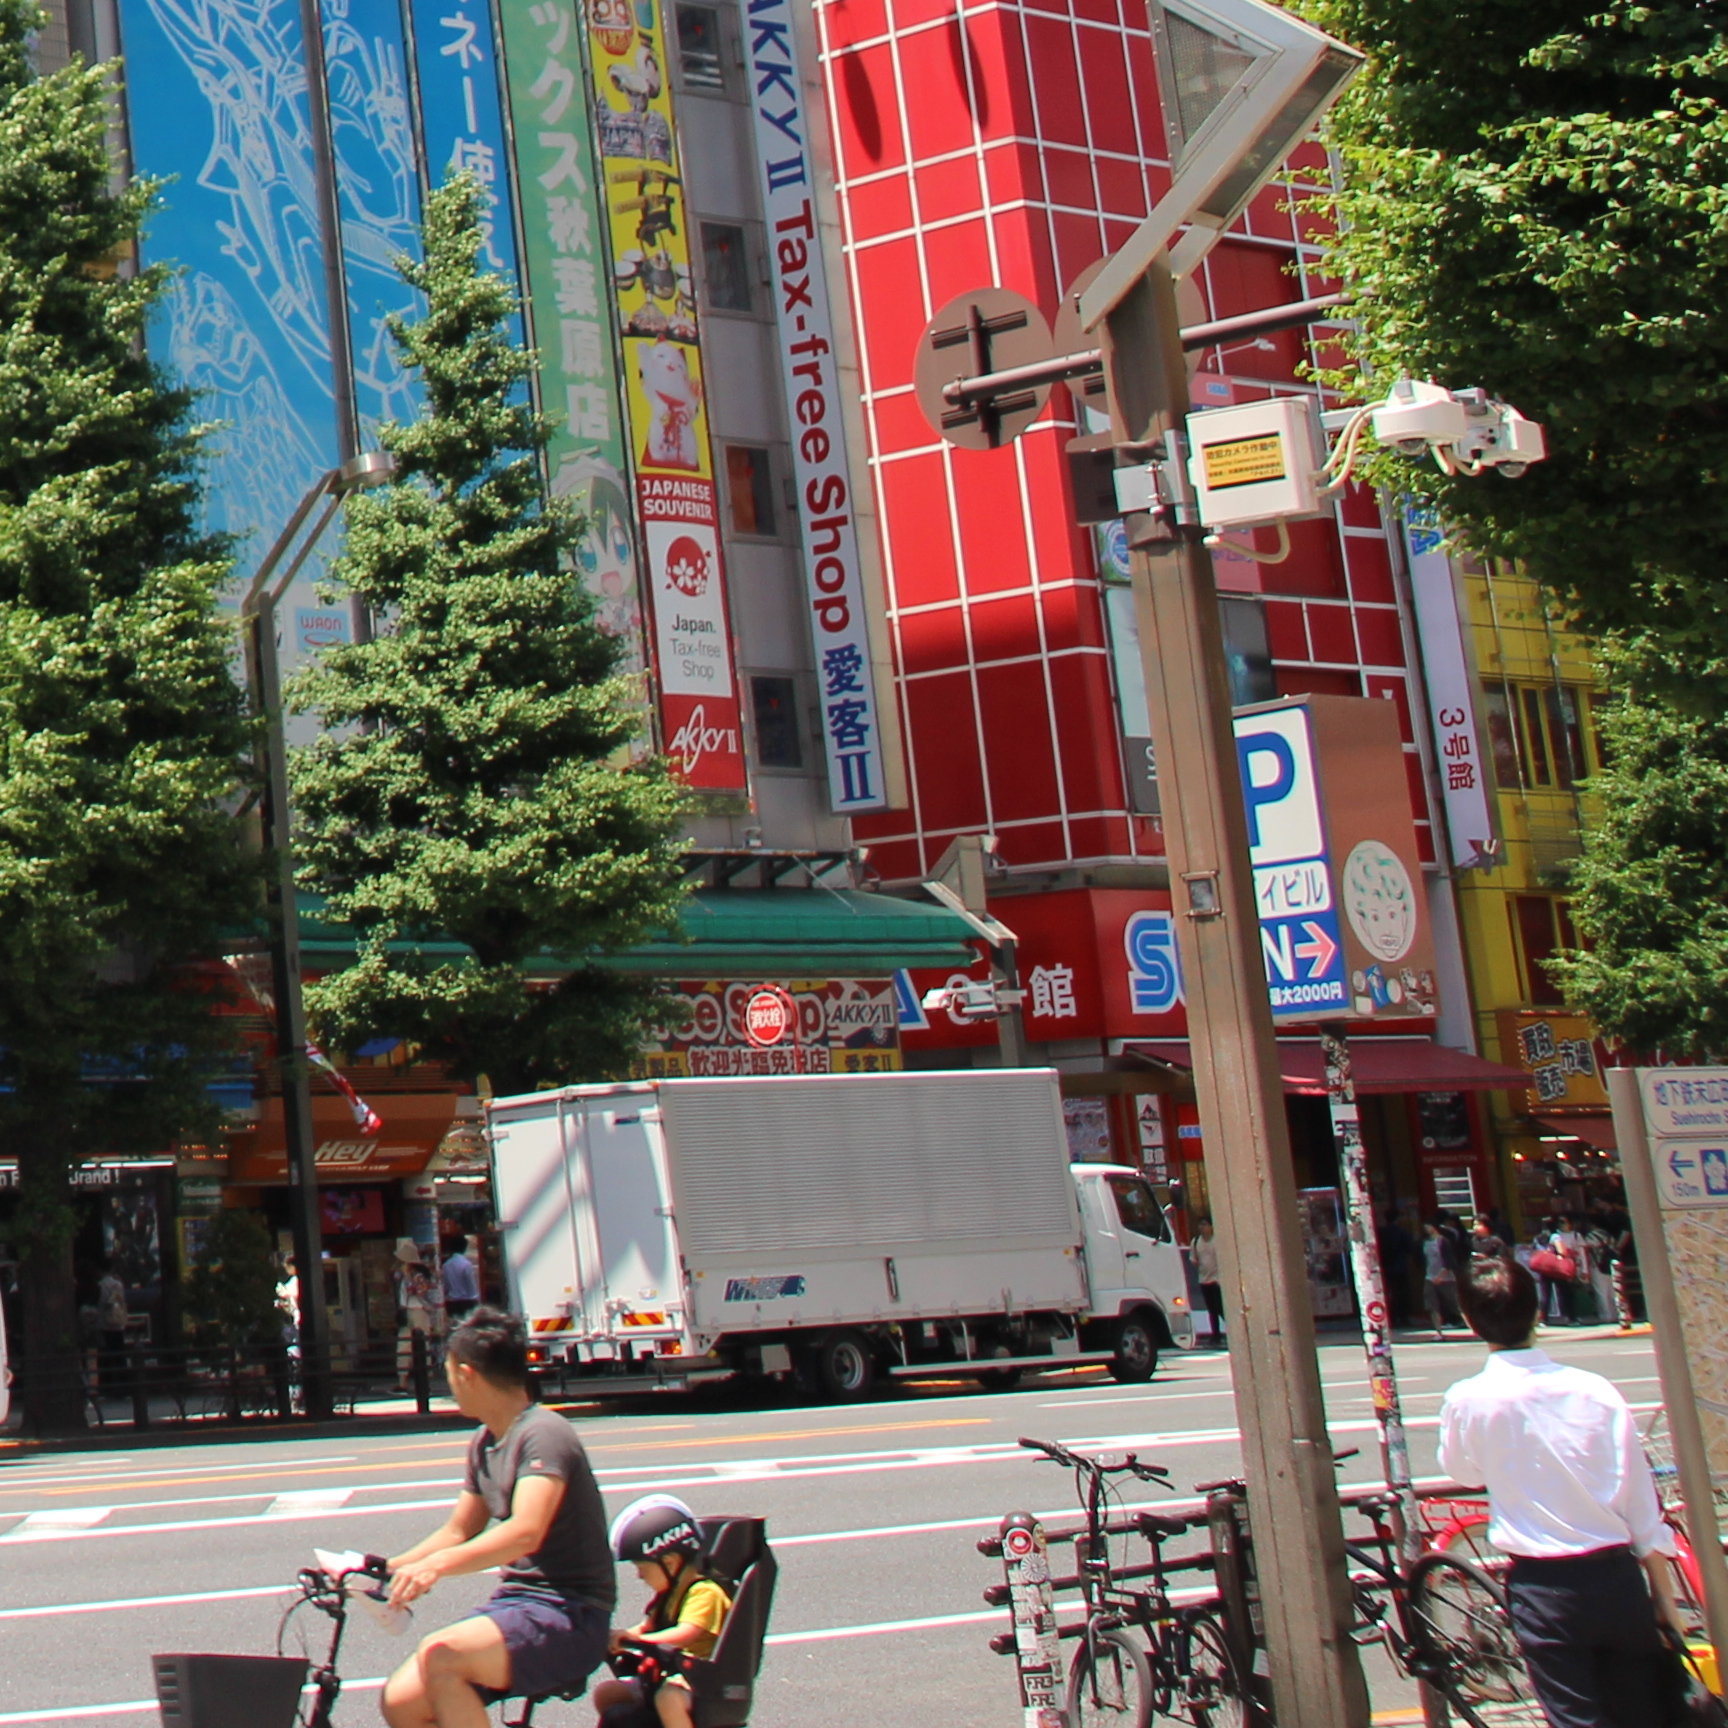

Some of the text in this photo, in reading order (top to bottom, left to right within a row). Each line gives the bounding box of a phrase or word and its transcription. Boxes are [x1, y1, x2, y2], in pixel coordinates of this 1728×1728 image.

[775, 198, 831, 466] Tax-free
[806, 474, 852, 634] Shop
[642, 480, 712, 503] JAPANESE
[643, 497, 714, 521] SOUVENIR
[670, 636, 722, 660] Tax-free
[681, 659, 715, 682] Shop
[1439, 707, 1476, 791] 3号館
[1235, 730, 1297, 847] P
[829, 1003, 878, 1024] AKKY
[314, 1140, 378, 1165] Hey
